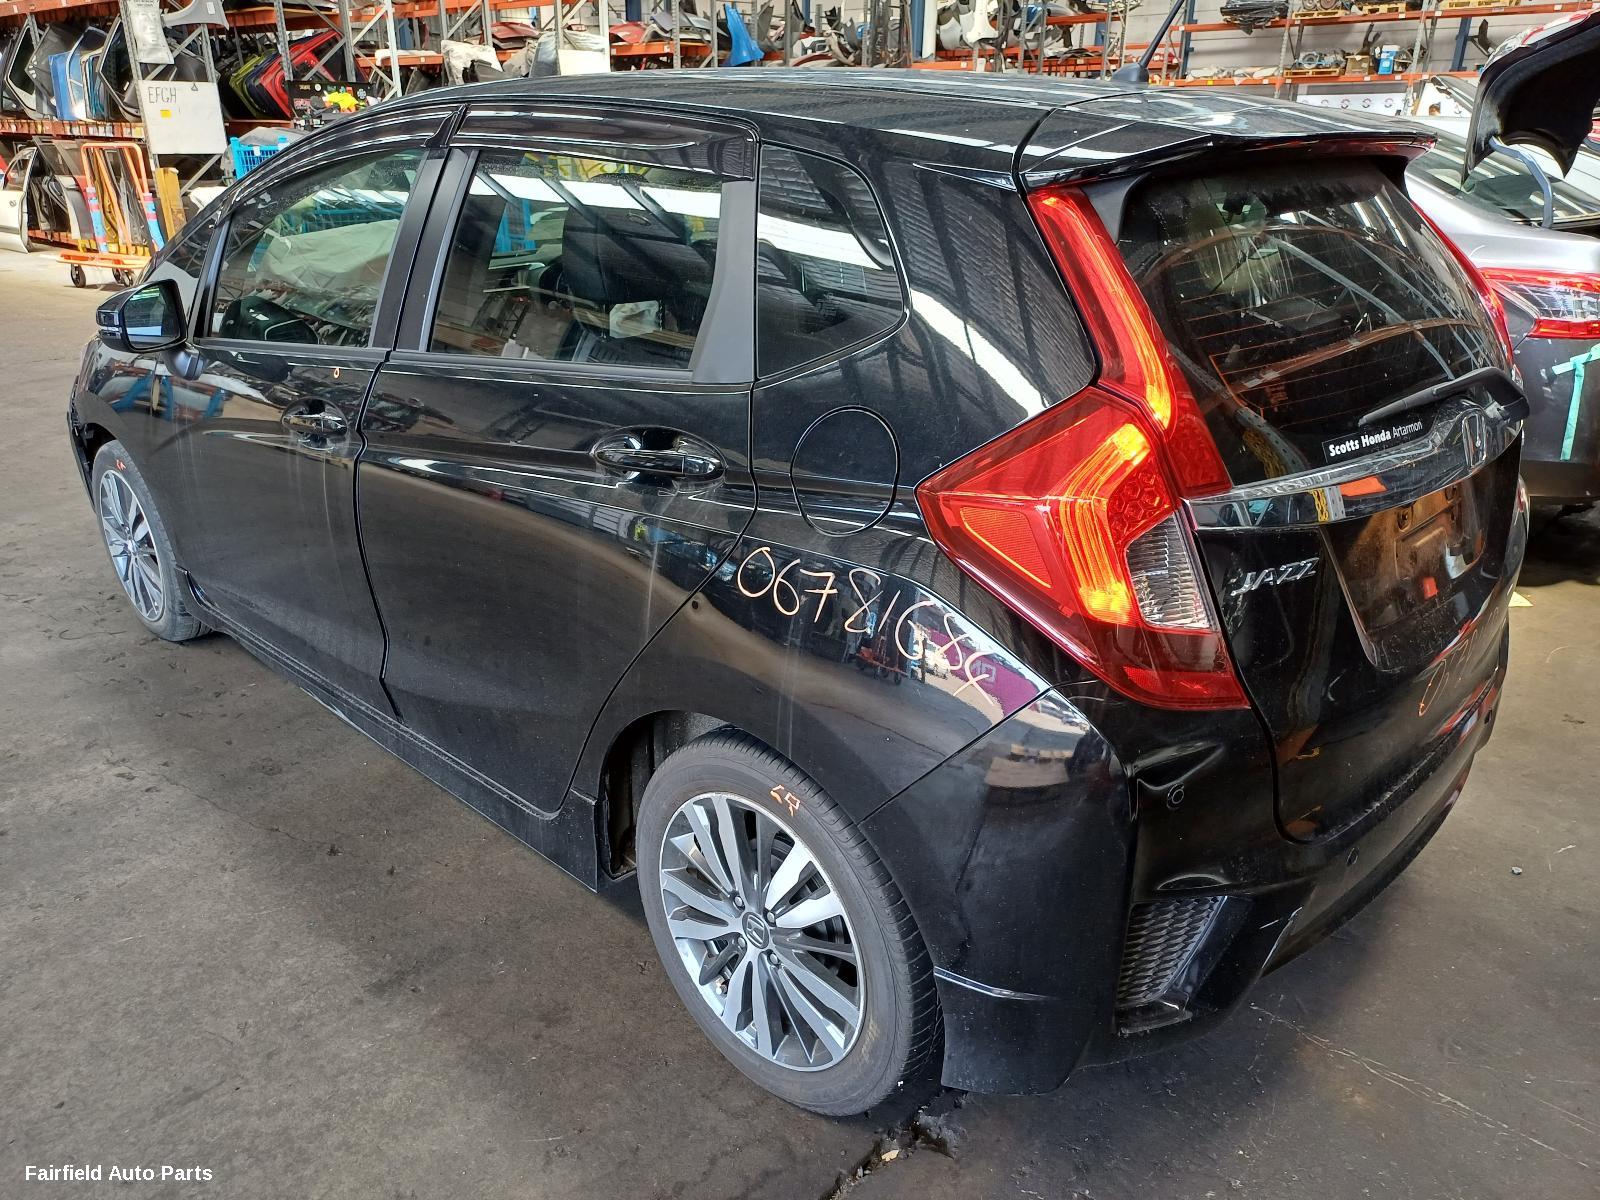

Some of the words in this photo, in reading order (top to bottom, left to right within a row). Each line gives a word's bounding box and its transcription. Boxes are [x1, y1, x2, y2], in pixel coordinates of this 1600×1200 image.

[148, 86, 177, 104] EFGH
[1328, 439, 1360, 457] Scotts
[1361, 429, 1392, 448] Honda
[1392, 421, 1423, 438] Artarmon
[1230, 556, 1320, 597] JAZZ
